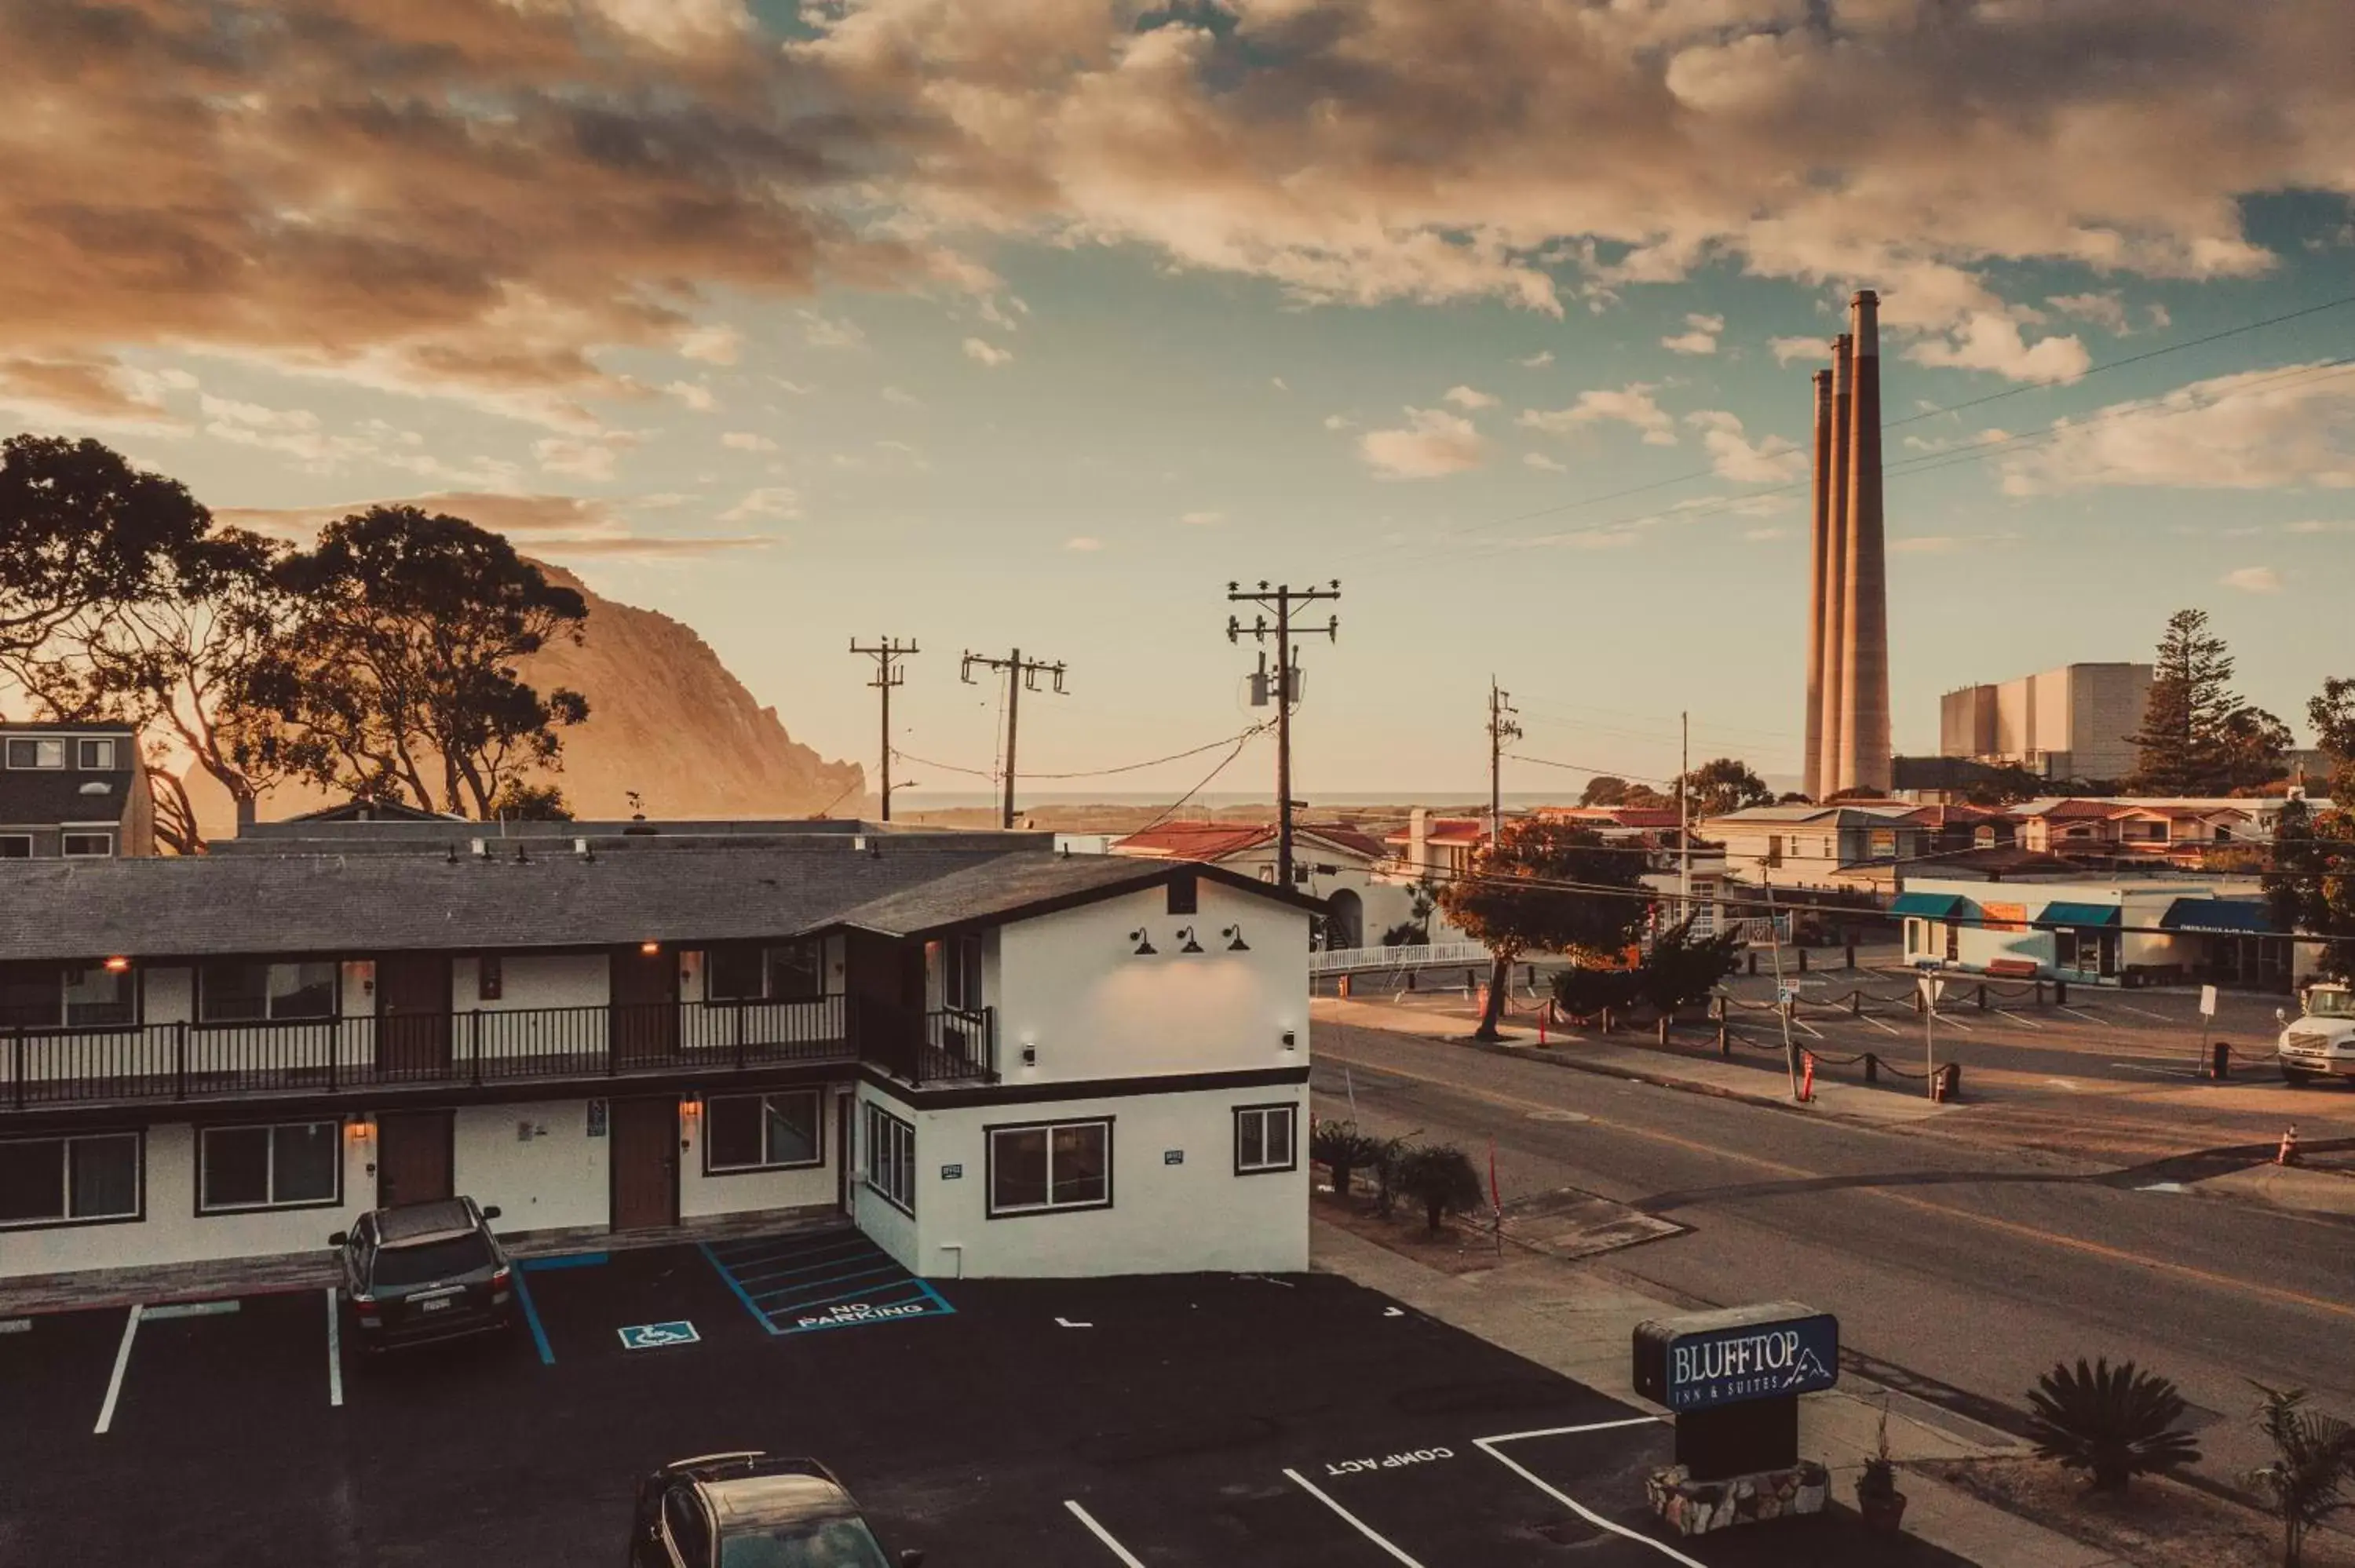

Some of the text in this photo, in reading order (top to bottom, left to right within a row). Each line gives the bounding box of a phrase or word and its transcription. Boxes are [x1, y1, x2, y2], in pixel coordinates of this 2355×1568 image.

[797, 1304, 924, 1328] PARKING
[829, 1303, 871, 1315] NO
[1674, 1330, 1799, 1384] BLUFFTOP
[1674, 1375, 1779, 1406] INN & SUITES
[1325, 1446, 1455, 1476] COMPACT
